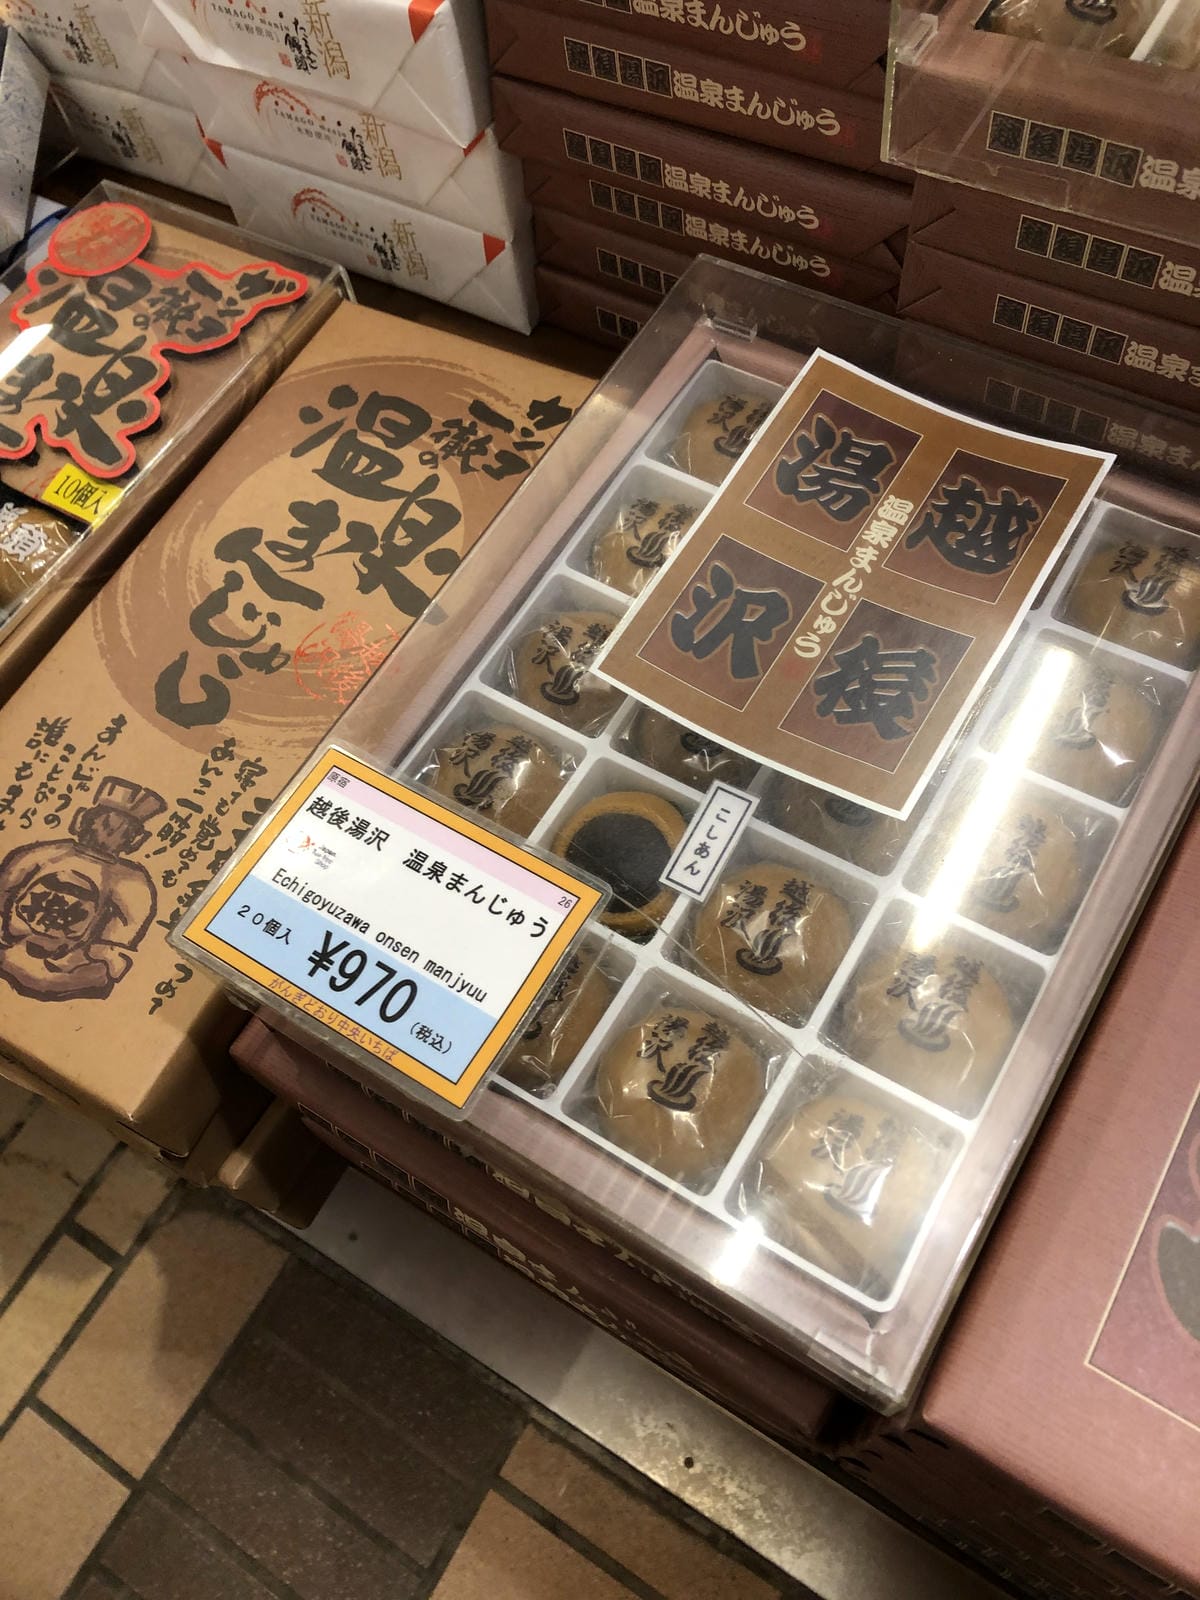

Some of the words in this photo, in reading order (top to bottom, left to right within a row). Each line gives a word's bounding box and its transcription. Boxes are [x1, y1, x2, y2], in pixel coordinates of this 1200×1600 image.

[303, 0, 350, 80] 新潟
[673, 70, 841, 136] 温泉まんじゅう
[359, 111, 402, 180] 新潟
[664, 163, 820, 230] 温泉まんじゅう
[685, 213, 831, 278] 温泉まんじゅう
[1159, 261, 1200, 297] 温
[54, 475, 107, 514] 10個入
[793, 493, 914, 660] 温泉まんじゅう
[154, 498, 341, 729] まんじゅう
[19, 743, 77, 829] ことなら
[305, 795, 391, 852] 越後湯沢
[402, 848, 550, 940] 温泉まんじゅう
[682, 807, 732, 879] こしあん
[237, 903, 293, 946] 20個入
[271, 867, 370, 935] Echigoyuzawa
[375, 928, 420, 964] onsen
[423, 957, 488, 1004] manjyuu
[557, 896, 573, 910] 26
[308, 930, 419, 1024] ¥970
[267, 975, 399, 1062] がんぎどおり中央いちば
[408, 1020, 455, 1056] (税込)
